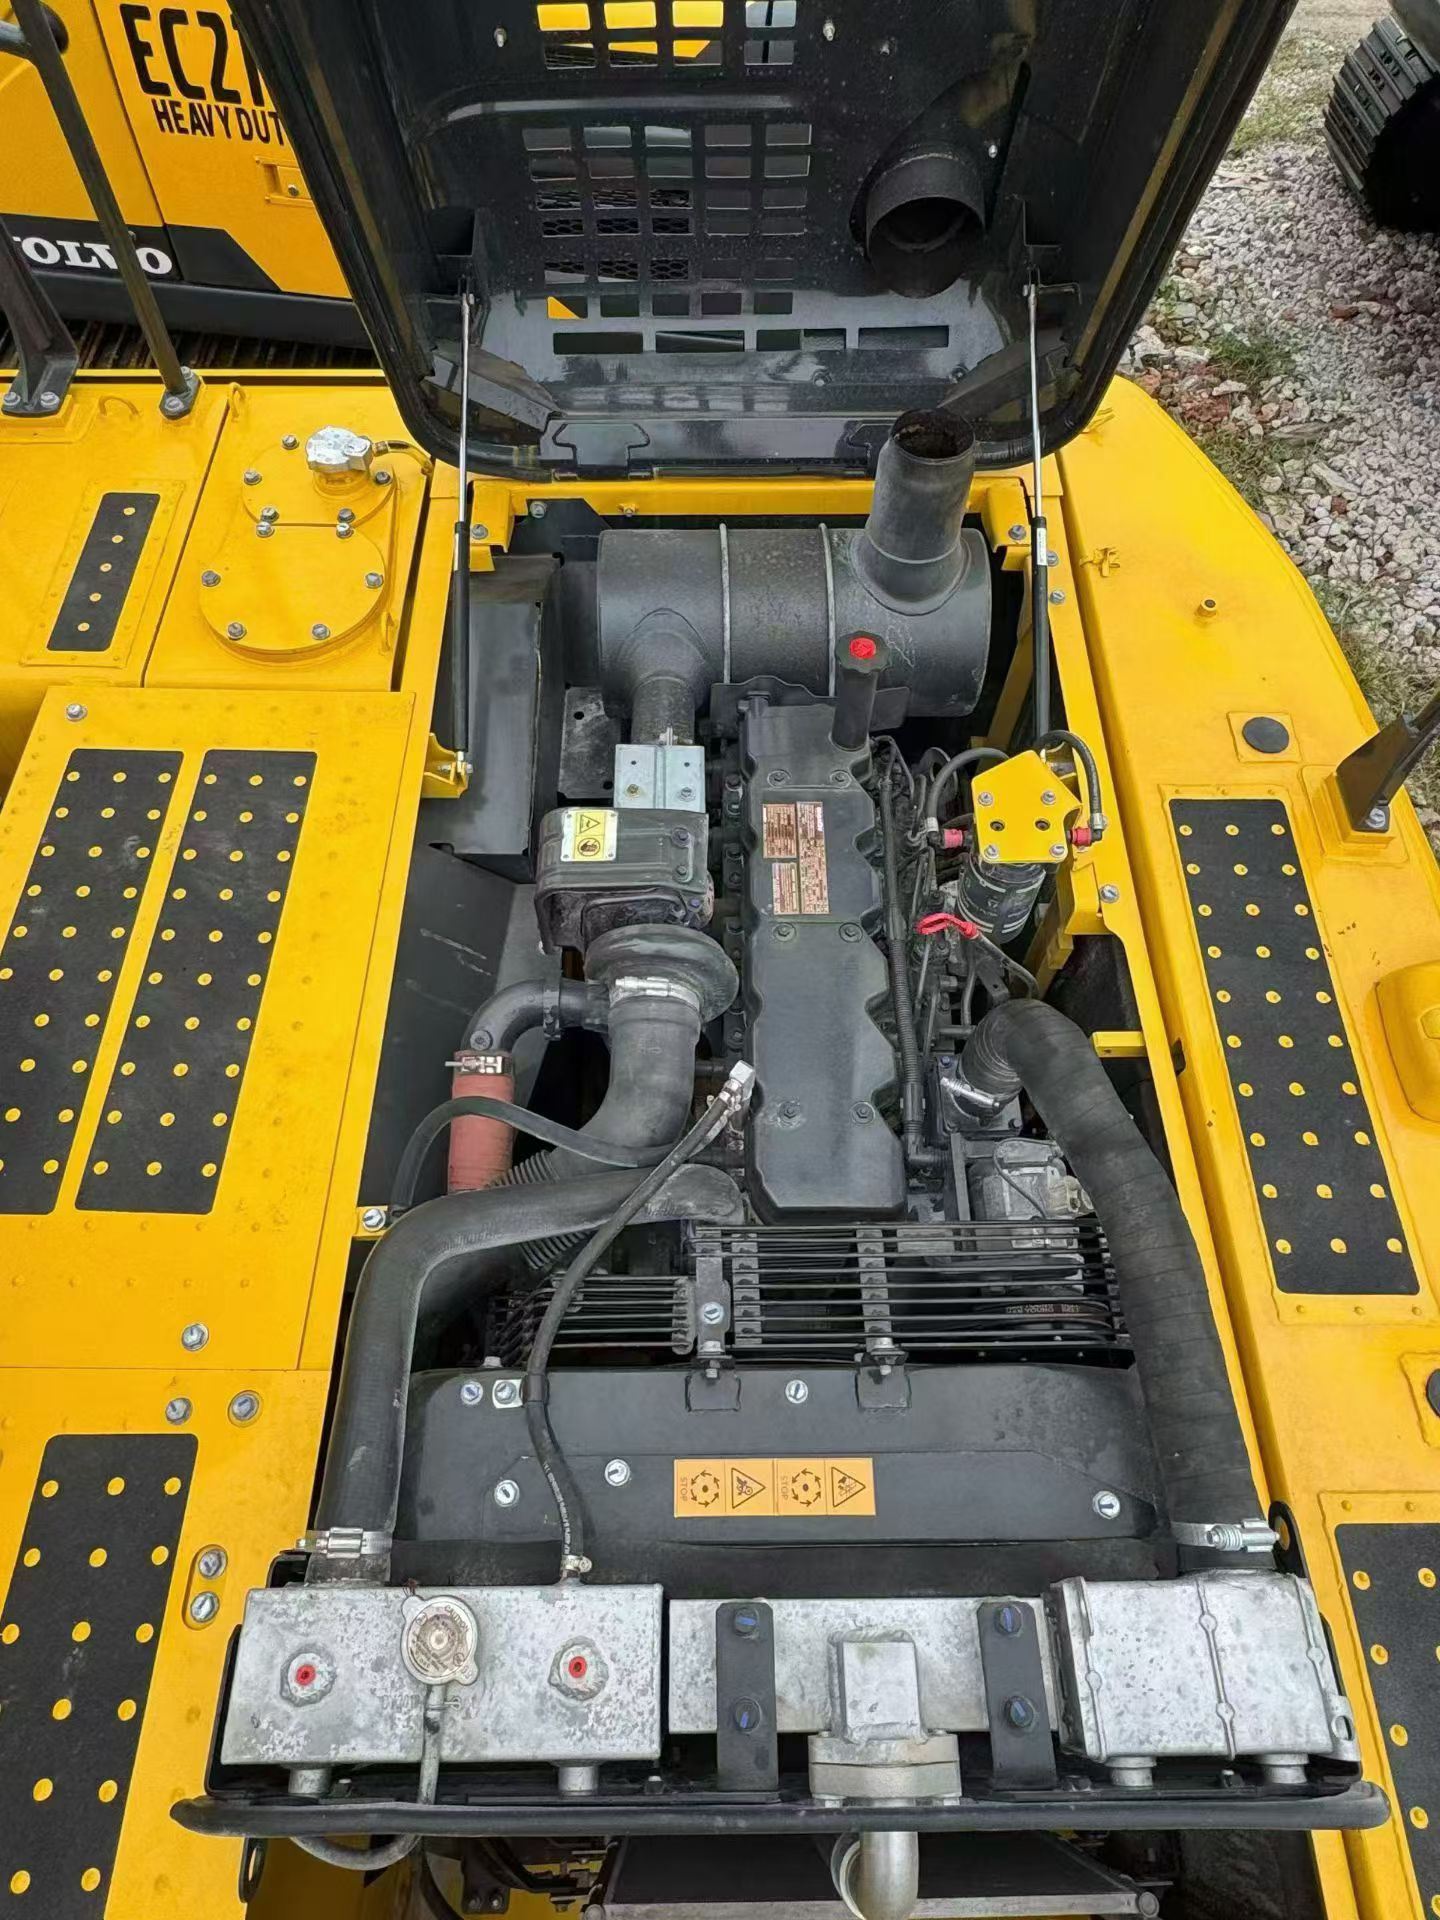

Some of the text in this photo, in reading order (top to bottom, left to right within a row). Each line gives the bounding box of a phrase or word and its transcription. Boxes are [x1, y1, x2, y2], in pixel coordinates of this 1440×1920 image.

[151, 98, 285, 147] HEAVY DUT
[12, 236, 173, 275] OLVO
[680, 1476, 688, 1502] STOP
[780, 1475, 789, 1501] STOP
